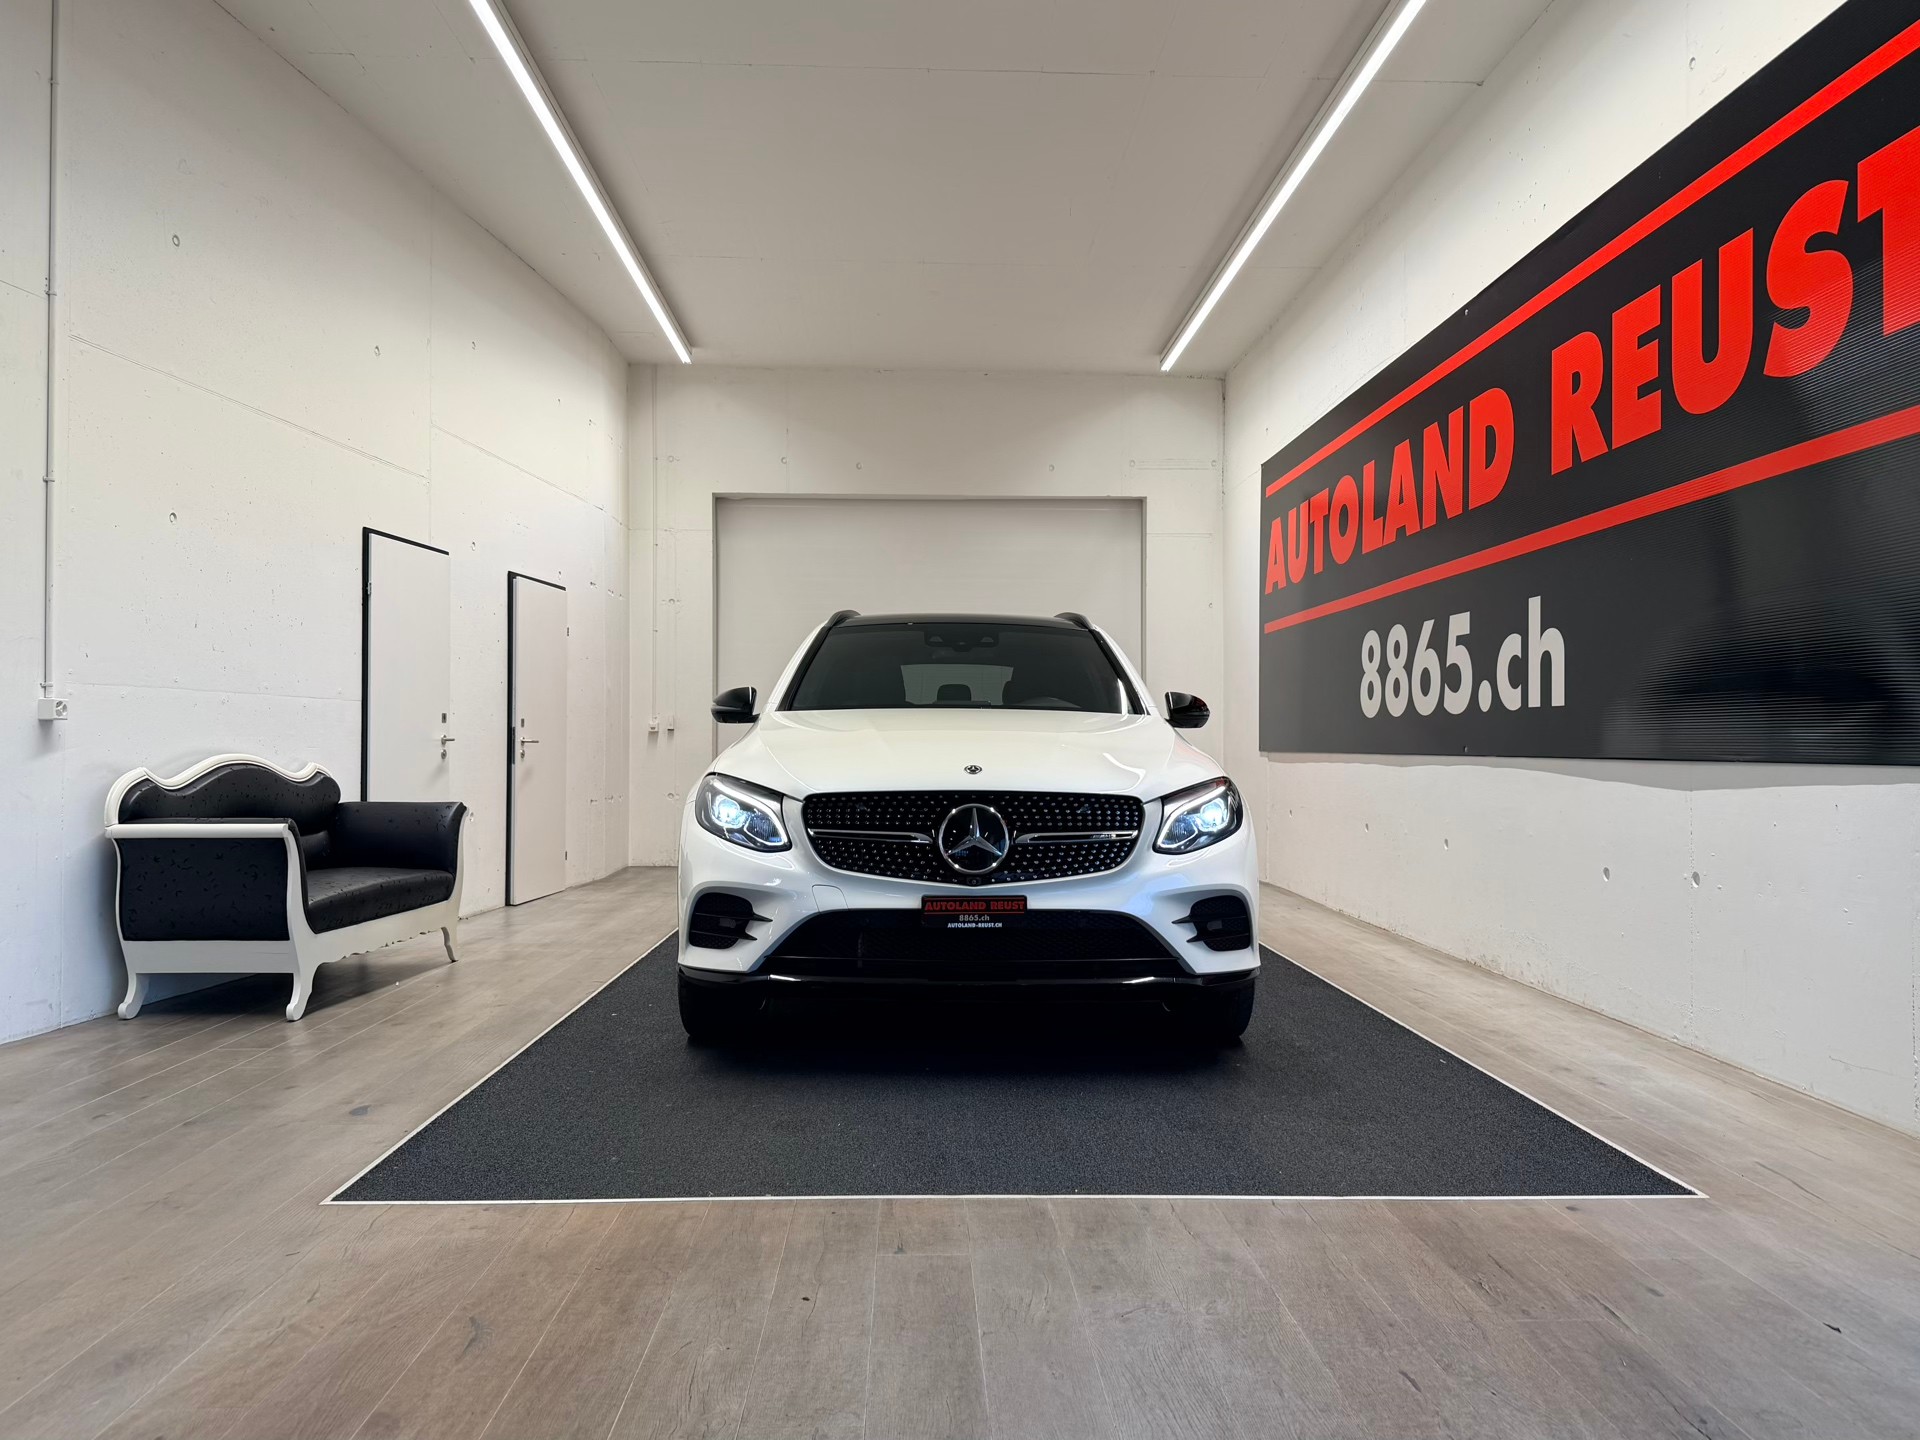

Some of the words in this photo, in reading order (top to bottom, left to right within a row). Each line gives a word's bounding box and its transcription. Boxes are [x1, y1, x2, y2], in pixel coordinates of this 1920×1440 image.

[1264, 388, 1514, 595] AUTOLAND
[1551, 125, 1920, 475] REUST
[1360, 596, 1565, 718] 8865.ch
[925, 902, 986, 910] AUTOLAND
[990, 901, 1024, 910] REUST
